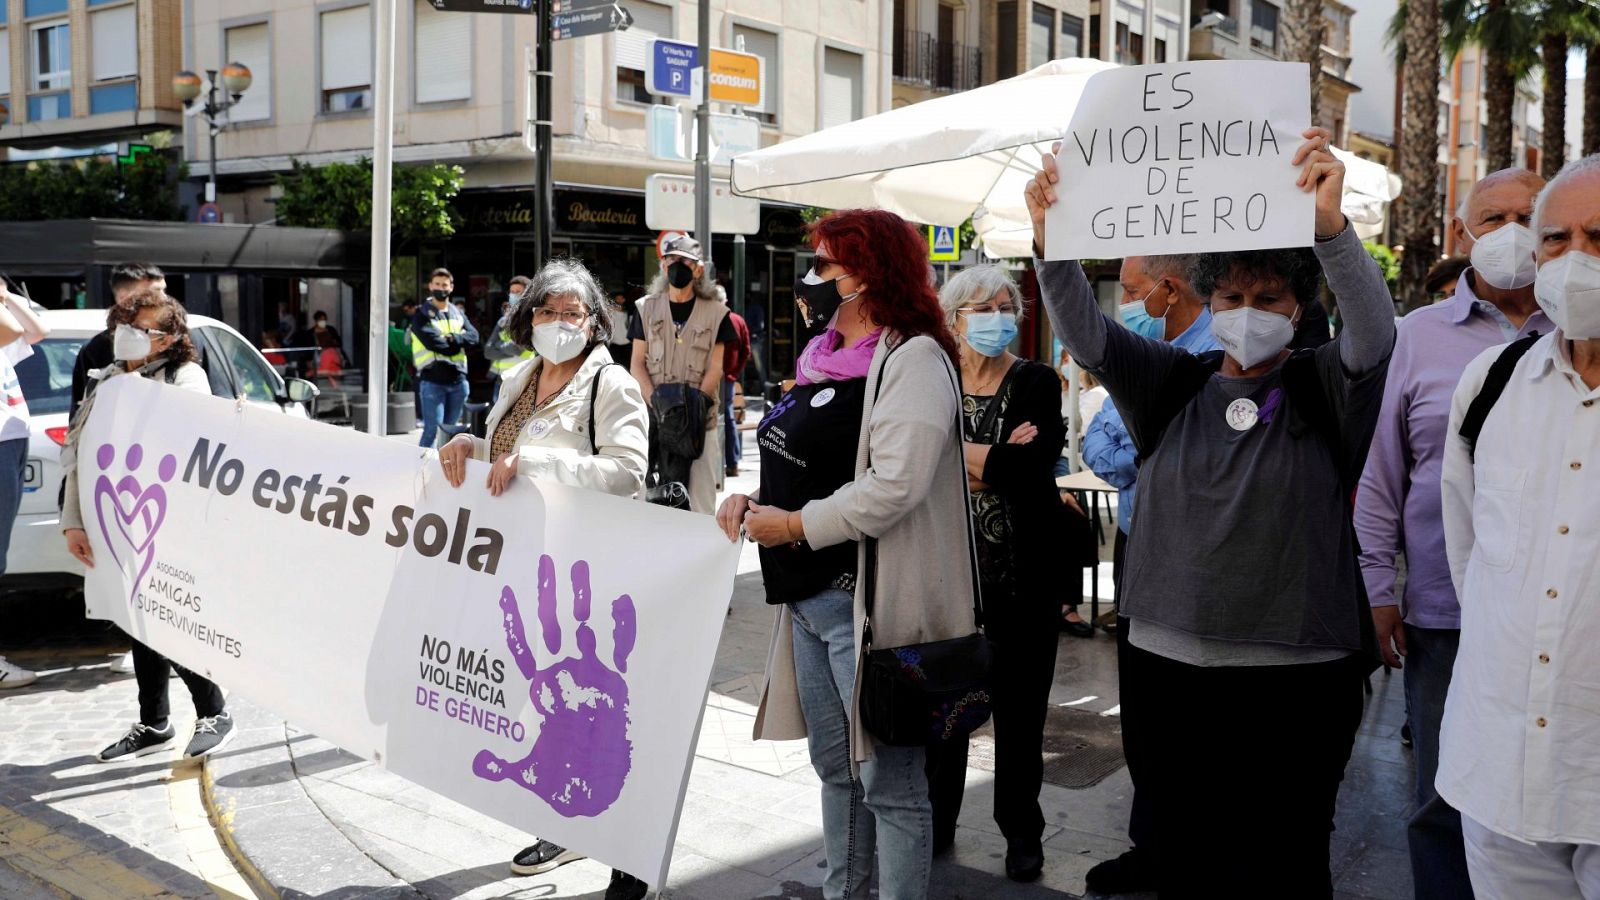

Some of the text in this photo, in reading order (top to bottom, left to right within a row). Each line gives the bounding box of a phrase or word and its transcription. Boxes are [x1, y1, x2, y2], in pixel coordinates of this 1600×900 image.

[672, 71, 682, 87] P
[710, 73, 757, 90] consum
[1143, 72, 1194, 111] ES
[1073, 120, 1280, 166] VIOLENCIA
[1147, 167, 1194, 195] DE
[1091, 193, 1267, 239] GENERO
[182, 436, 504, 576] No estás sola
[148, 576, 202, 613] AMIGAS
[156, 560, 196, 585] ASOCIACIÓN
[136, 593, 243, 659] SUPERVIVIENTES
[420, 634, 505, 685] NO MÁS
[419, 661, 506, 709] VIOLENCIA
[415, 685, 525, 743] DE GÉNERO
